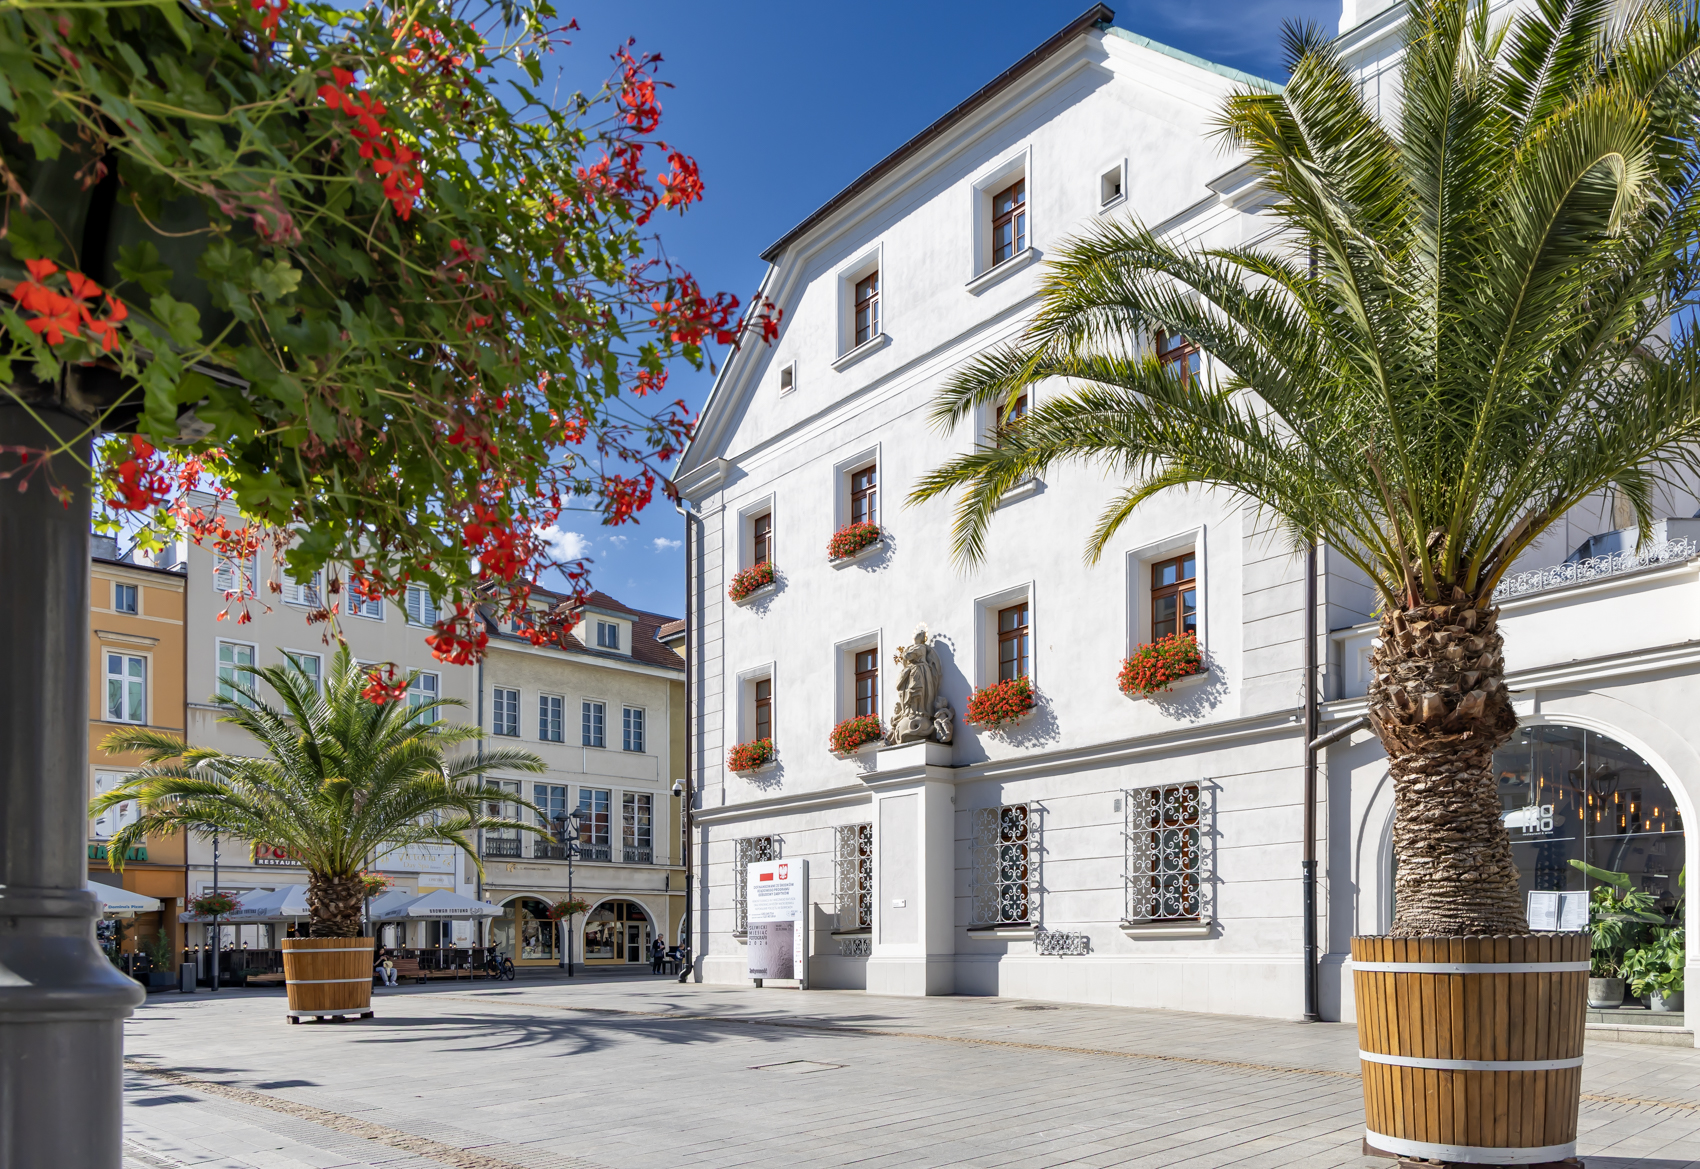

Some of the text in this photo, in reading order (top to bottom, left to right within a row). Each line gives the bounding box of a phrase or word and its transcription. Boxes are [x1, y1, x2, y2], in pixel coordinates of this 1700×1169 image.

[1522, 804, 1553, 818] mo
[1522, 818, 1553, 832] mo
[88, 845, 148, 861] KAKA
[397, 851, 436, 862] Victoria
[258, 859, 312, 867] RESTAURA
[403, 862, 416, 870] Day
[418, 862, 430, 871] Spa
